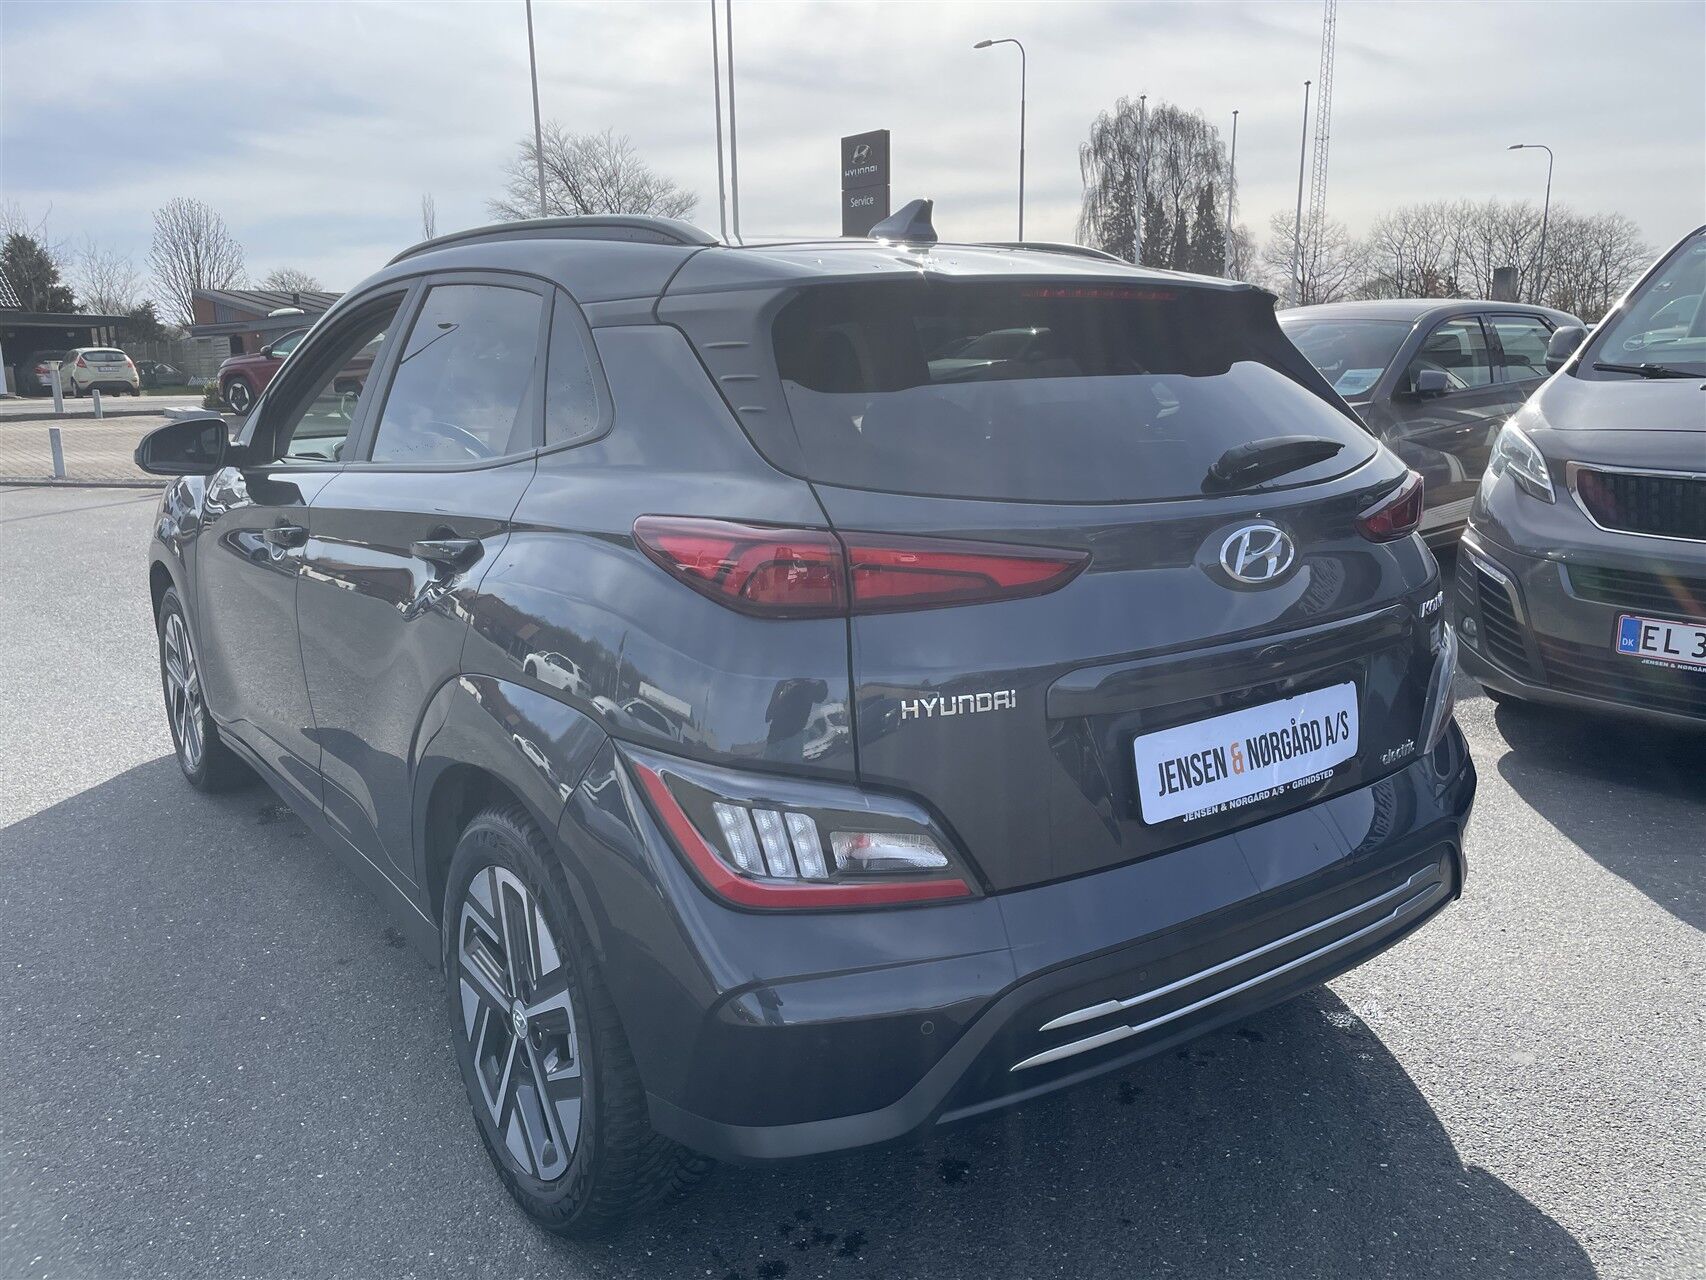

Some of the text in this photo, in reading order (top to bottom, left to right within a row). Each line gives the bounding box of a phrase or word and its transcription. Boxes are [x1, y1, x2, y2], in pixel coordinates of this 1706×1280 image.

[844, 165, 878, 177] HYUNDAI
[850, 196, 874, 208] Service
[1622, 637, 1634, 647] DK
[1641, 625, 1680, 655] EL
[1641, 659, 1669, 668] JENSEN
[901, 689, 1016, 720] HYUNDAI
[1158, 710, 1349, 797] JENSEN & NØRGÅRD A/S
[1183, 769, 1334, 823] JENSEN & NØRGÅRD A/S GRINDSTED
